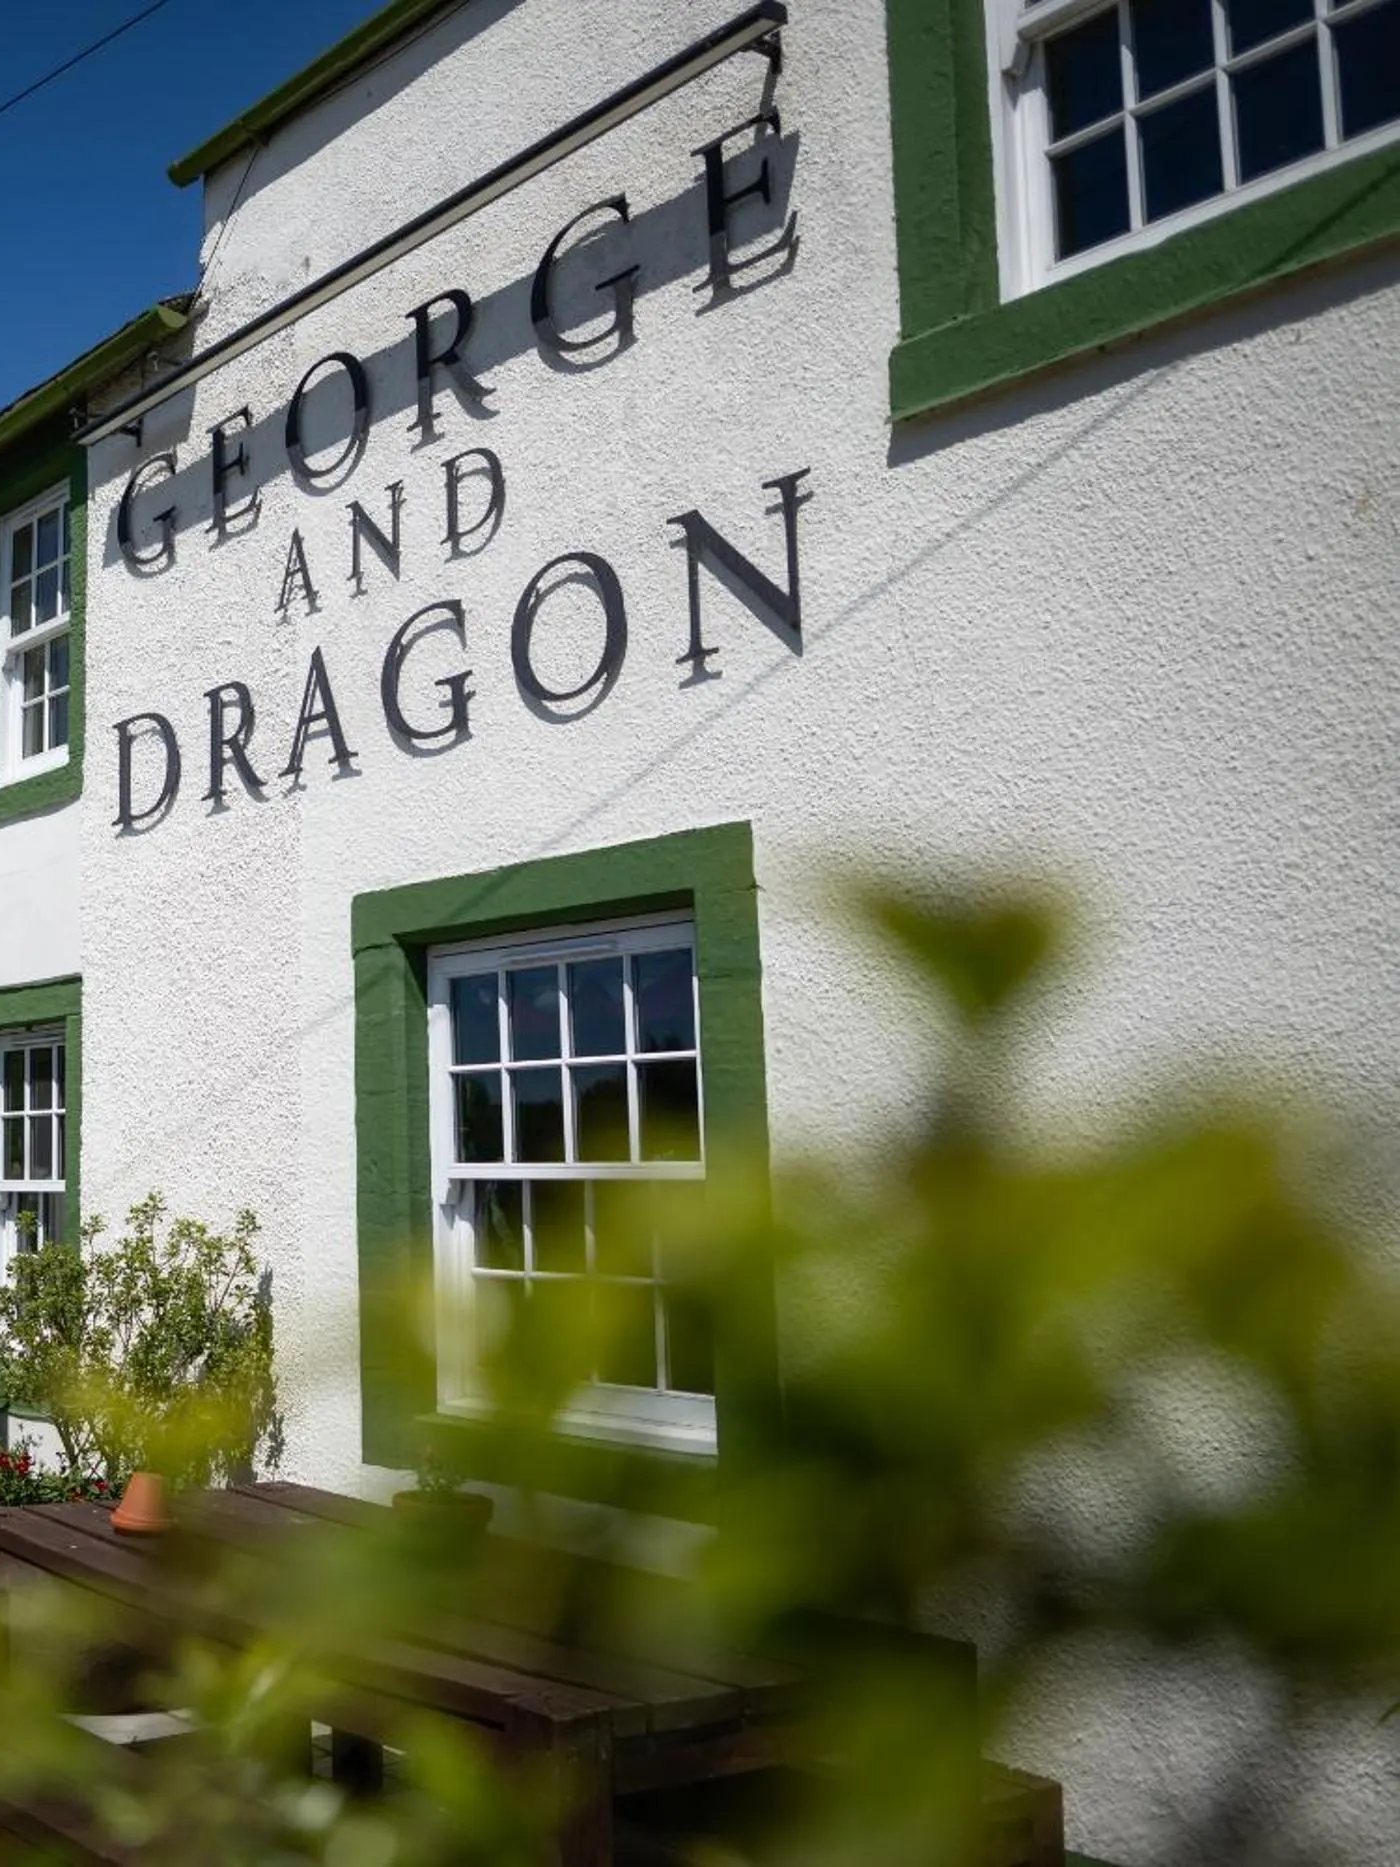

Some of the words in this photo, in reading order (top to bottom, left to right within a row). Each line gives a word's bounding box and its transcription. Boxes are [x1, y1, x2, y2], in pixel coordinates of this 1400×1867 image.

[116, 112, 799, 566] GEORGE
[111, 467, 812, 828] DRAGON
[275, 447, 504, 614] AND
